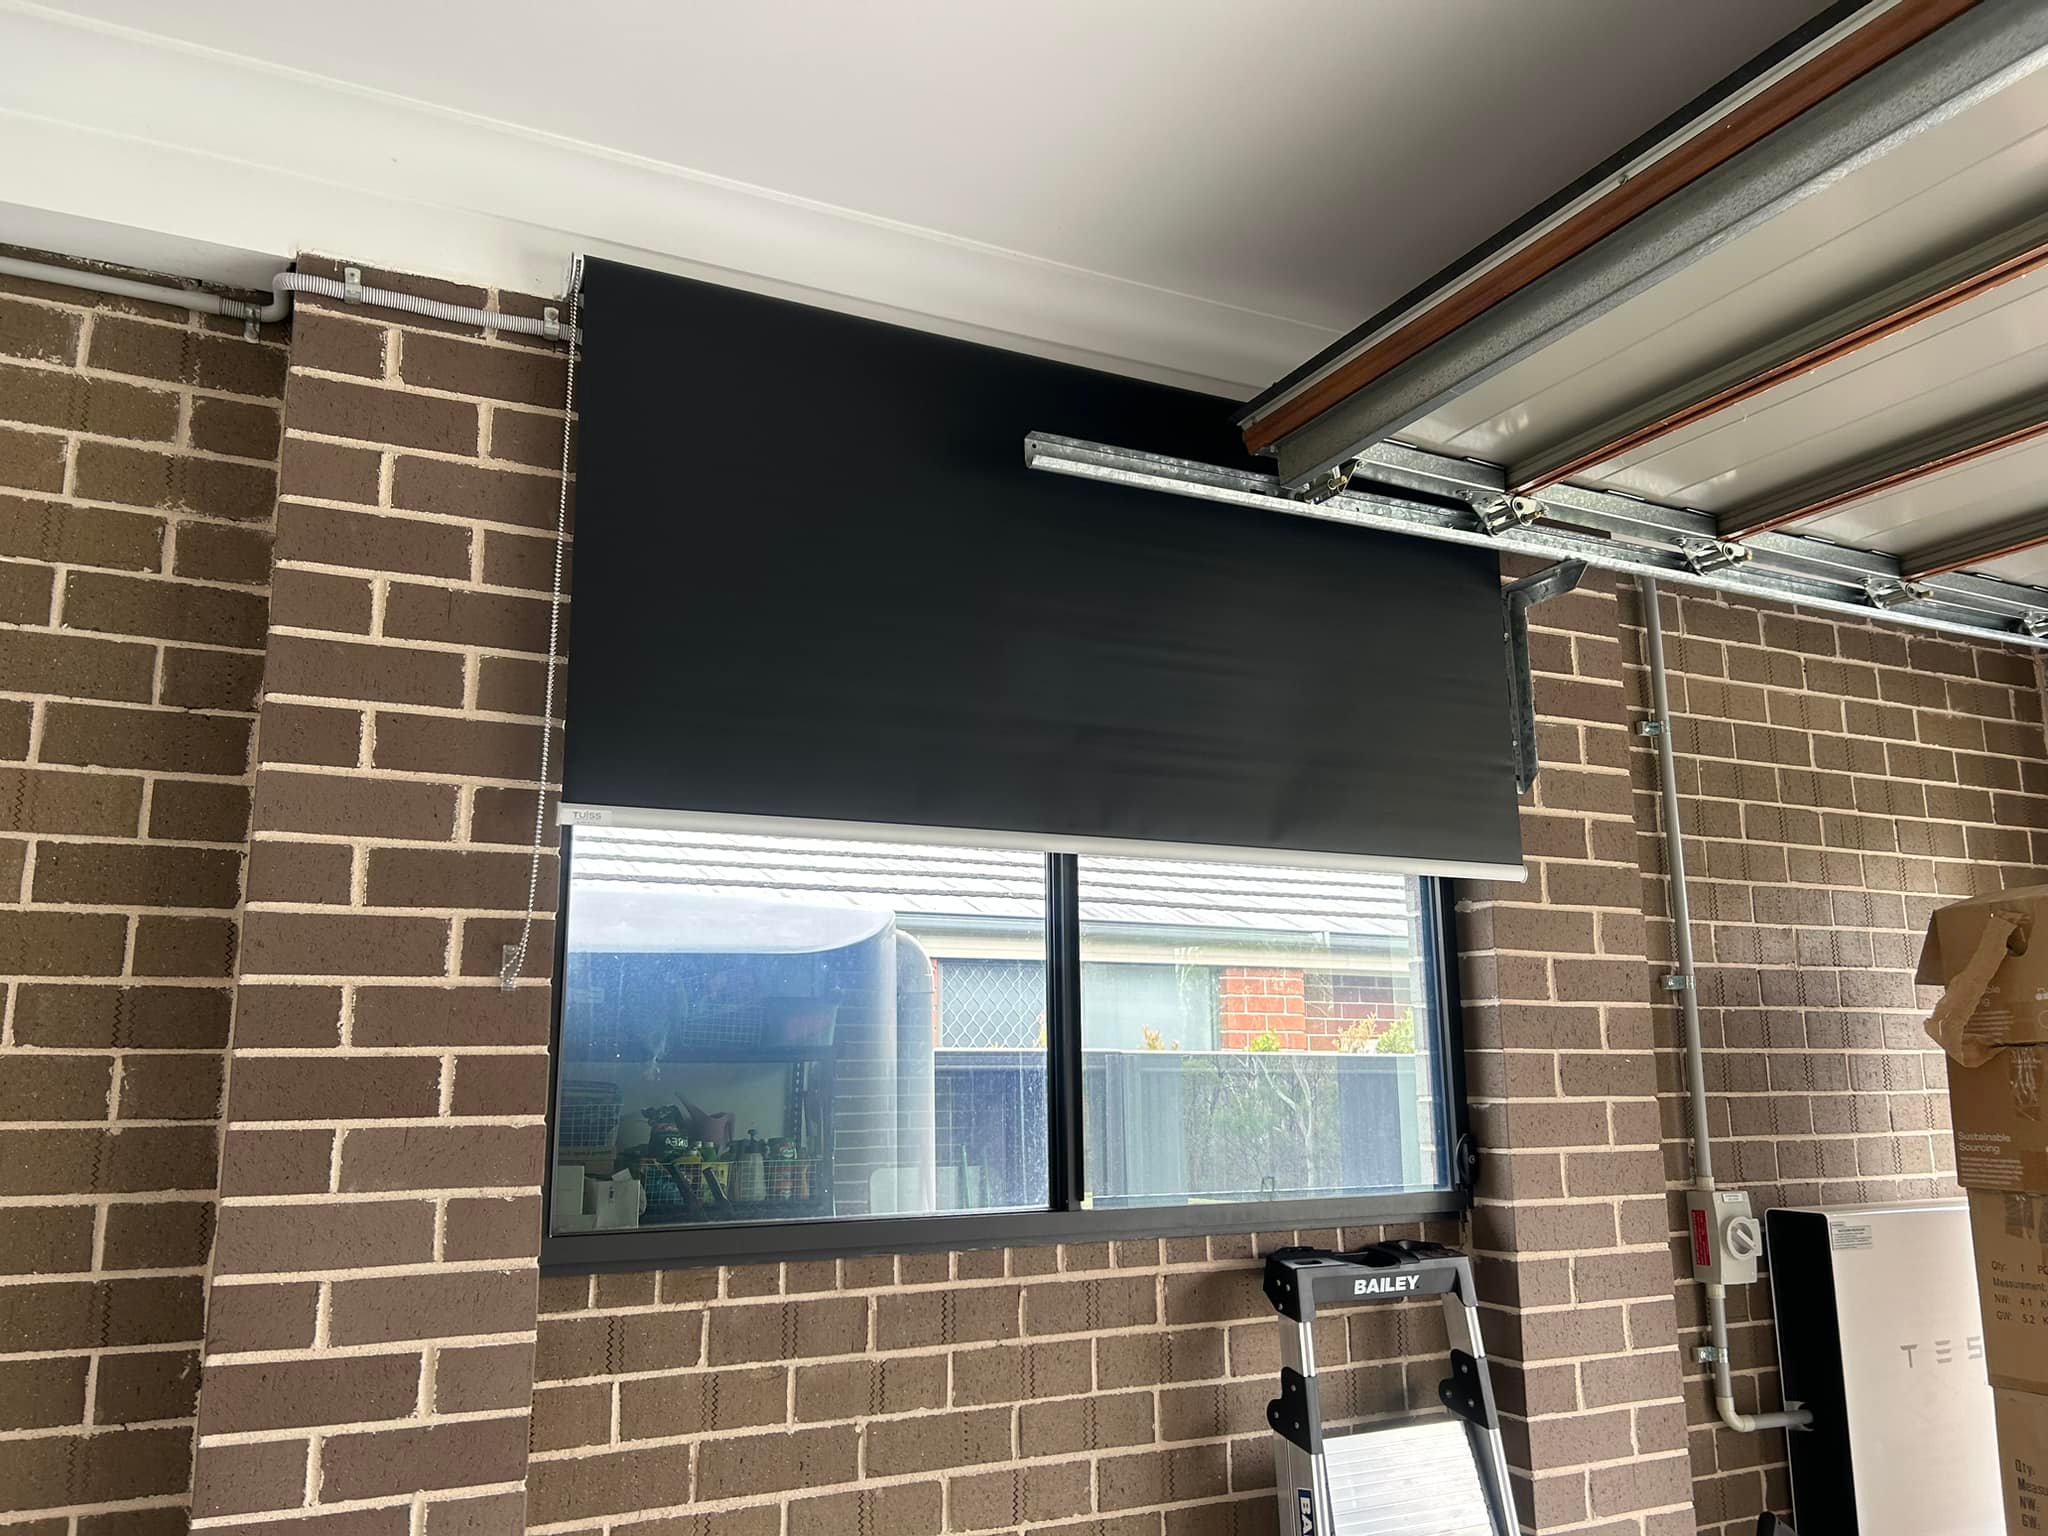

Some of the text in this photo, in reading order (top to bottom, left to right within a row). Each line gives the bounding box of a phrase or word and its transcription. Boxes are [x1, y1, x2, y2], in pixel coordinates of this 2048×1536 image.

[1958, 1131, 2010, 1142] Sustainable
[1959, 1143, 2000, 1155] Sourcing
[1354, 1275, 1420, 1295] BAILEY
[1300, 1497, 1313, 1536] BA
